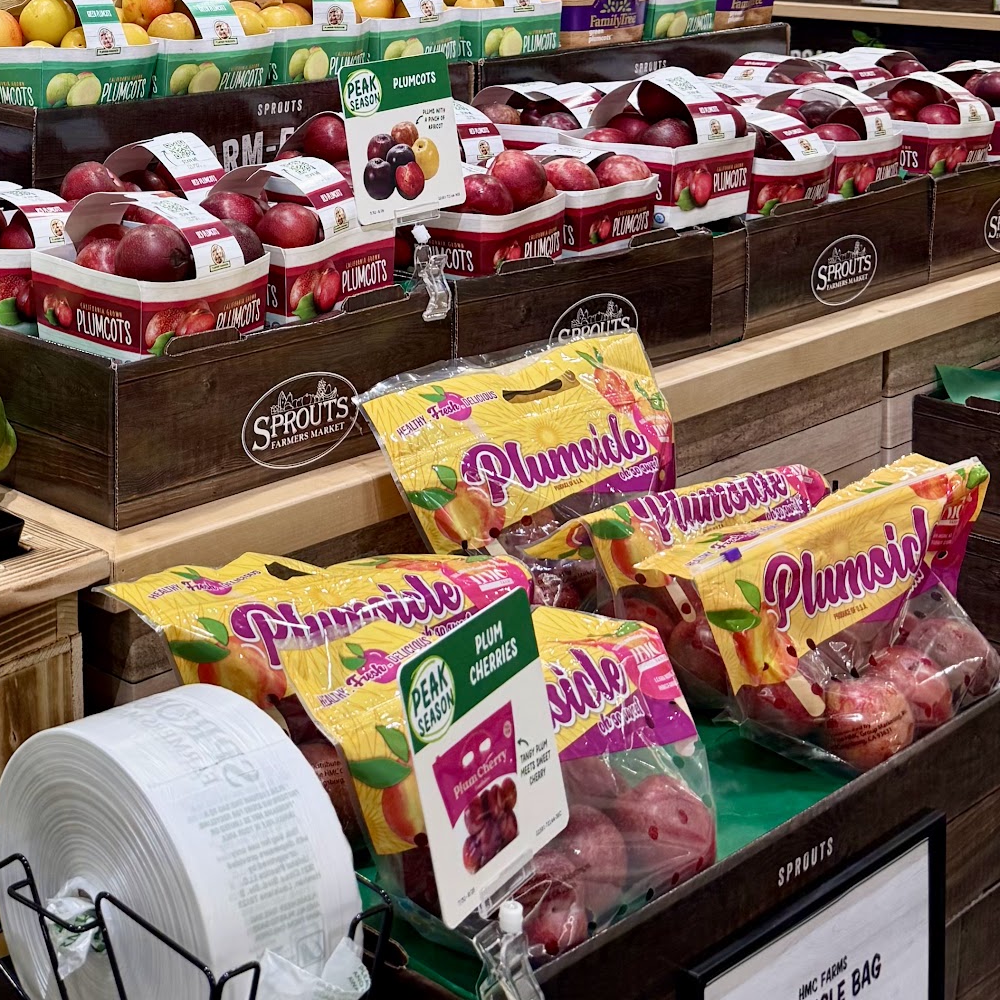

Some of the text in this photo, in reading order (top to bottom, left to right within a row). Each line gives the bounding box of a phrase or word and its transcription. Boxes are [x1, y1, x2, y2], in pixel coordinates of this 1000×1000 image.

[590, 12, 637, 29] FamilyTree
[523, 32, 557, 54] PLUMCOTS
[219, 67, 264, 91] PLUMCOTS
[634, 60, 667, 74] SPROUTS
[101, 78, 147, 103] PLUMCOTS
[347, 75, 378, 99] PEAK
[392, 71, 436, 90] PLUMCOTS
[257, 99, 303, 116] SPROUTS
[350, 92, 381, 112] SEASON
[713, 167, 747, 193] PLUMCOTS
[612, 209, 650, 238] PLUMCOTS
[524, 230, 560, 259] PLUMCOTS
[341, 258, 388, 294] PLUMCOTS
[815, 254, 872, 291] SPROUTS
[826, 273, 869, 290] FARMERS MARKET
[79, 302, 123, 318] CALIFORNIA GROWN
[216, 297, 261, 330] PLUMCOTS
[76, 308, 132, 346] PLUMCOTS
[426, 400, 460, 420] Fresh
[461, 390, 498, 408] DELICIOUS
[252, 396, 349, 451] SPROUTS
[270, 421, 346, 450] FARMERS MARKET
[396, 415, 428, 438] HEALTHY
[459, 413, 653, 507] Plumsicle
[148, 584, 182, 600] HEALTHY
[181, 580, 218, 593] Fresh
[229, 573, 467, 671] Plumsicle
[386, 635, 433, 663] DELICIOUS
[475, 620, 503, 655] PLUM
[469, 637, 519, 686] CHERRIES
[345, 664, 387, 689] Fresh
[411, 661, 449, 716] PEAK
[316, 687, 350, 707] HEALTHY
[417, 690, 454, 738] SEASON
[859, 727, 878, 737] Group
[519, 738, 548, 763] TANGY PLUM
[520, 750, 551, 778] MEETS SWEET
[529, 767, 547, 786] CHERRY
[777, 836, 834, 887] SPROUTS
[798, 977, 818, 1000] HMC
[820, 955, 848, 988] FARMS
[851, 952, 881, 997] BAG
